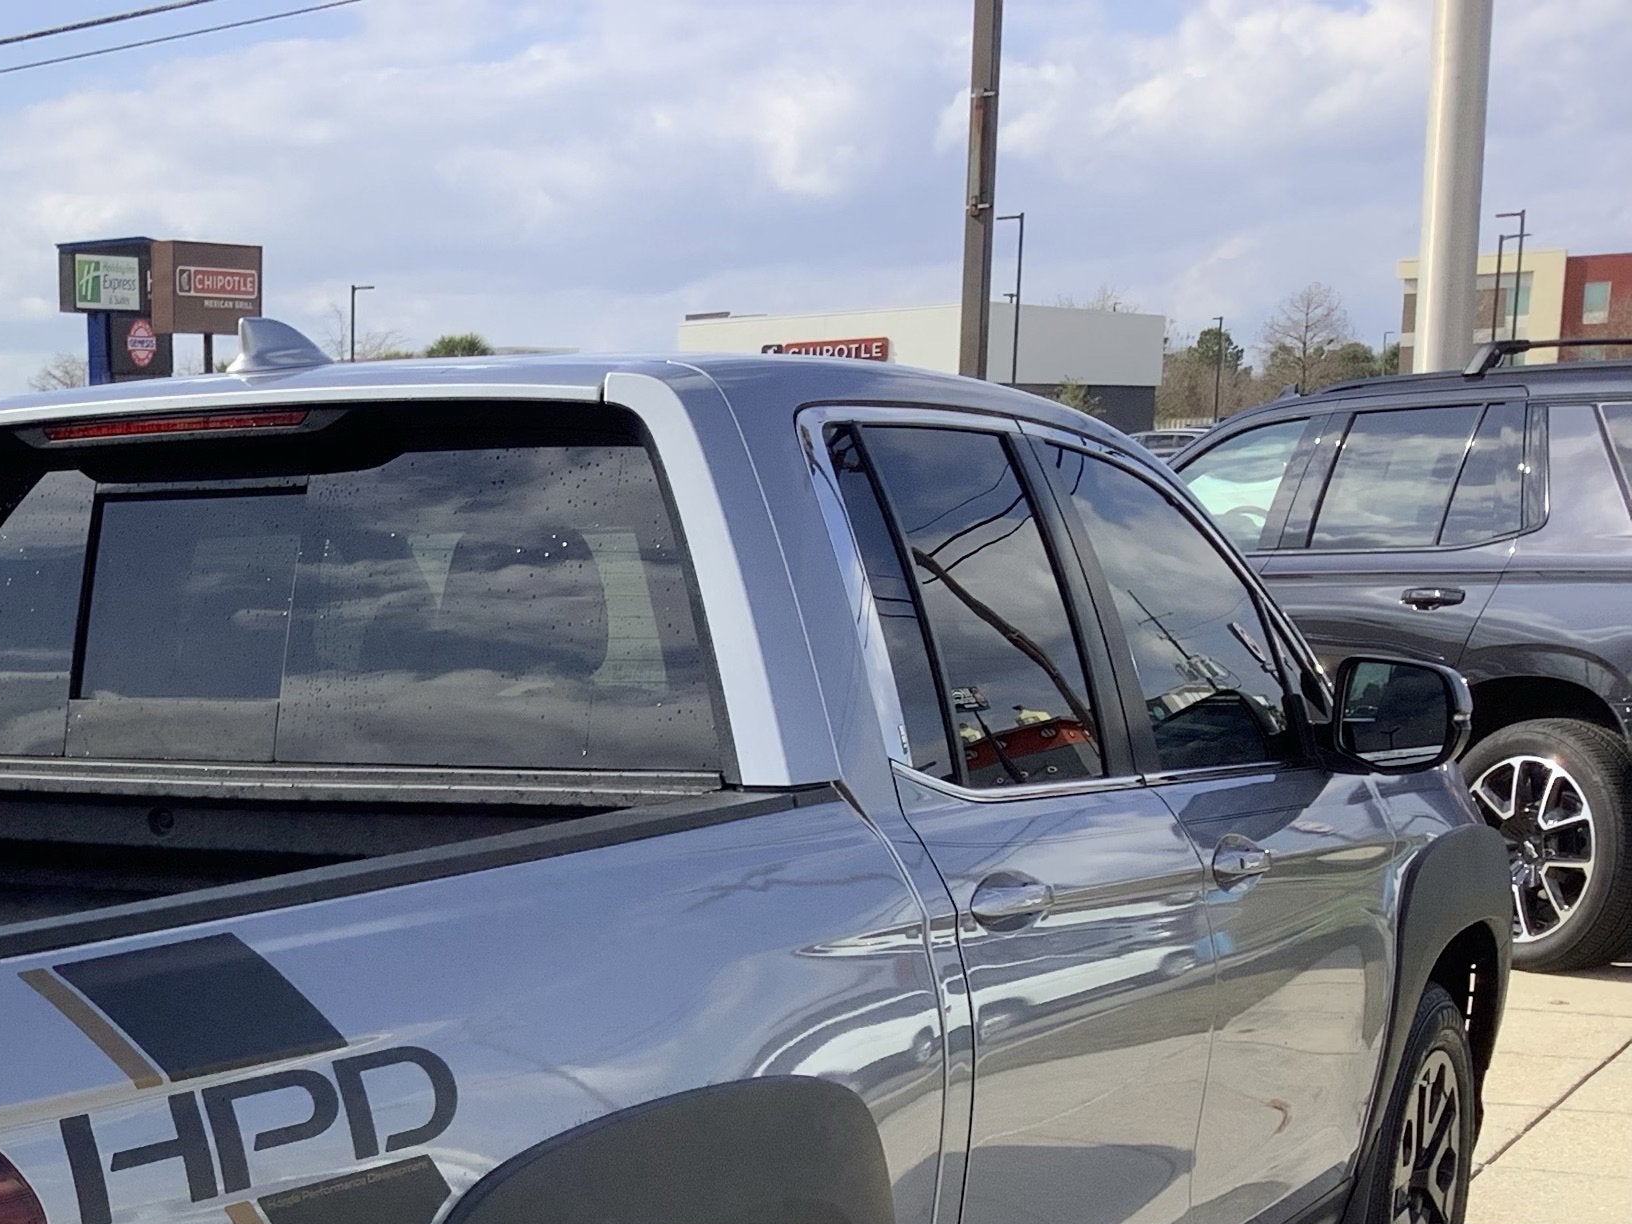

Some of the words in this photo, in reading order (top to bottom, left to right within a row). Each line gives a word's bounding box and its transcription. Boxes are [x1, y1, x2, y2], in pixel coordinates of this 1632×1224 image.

[103, 274, 137, 293] Express
[195, 274, 254, 292] CHIPOTLE
[204, 300, 233, 309] MEXICAN
[235, 301, 253, 310] GRILL
